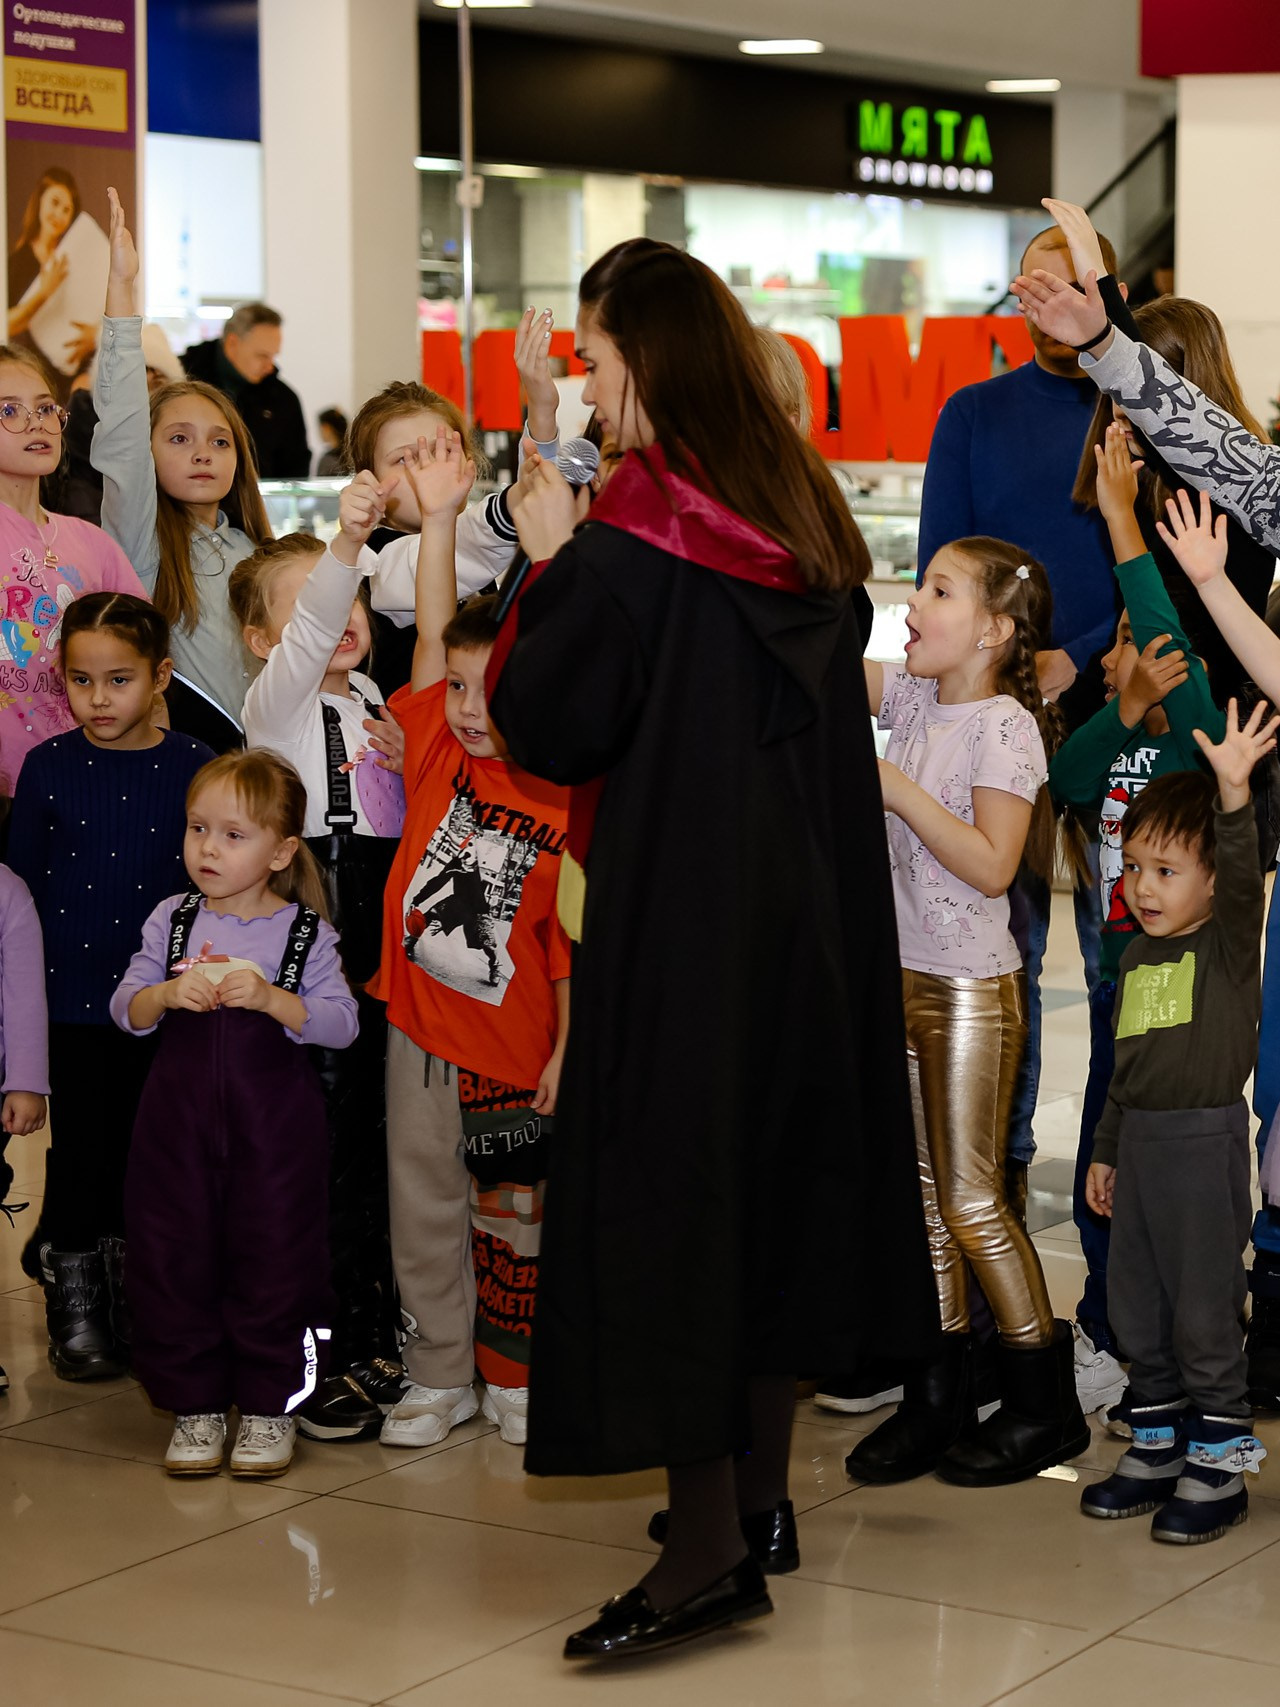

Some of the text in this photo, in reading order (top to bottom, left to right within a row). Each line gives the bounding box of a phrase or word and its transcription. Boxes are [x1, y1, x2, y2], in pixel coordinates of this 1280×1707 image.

[13, 3, 125, 34] Ортопедические
[13, 30, 76, 51] подушки
[16, 88, 94, 114] ВСЕГДА
[859, 100, 993, 165] МЯТА
[859, 156, 993, 194] SHOWROOM
[328, 723, 349, 806] FUTURINO
[934, 897, 958, 907] CAN
[965, 903, 981, 916] FLY
[172, 924, 184, 959] artel
